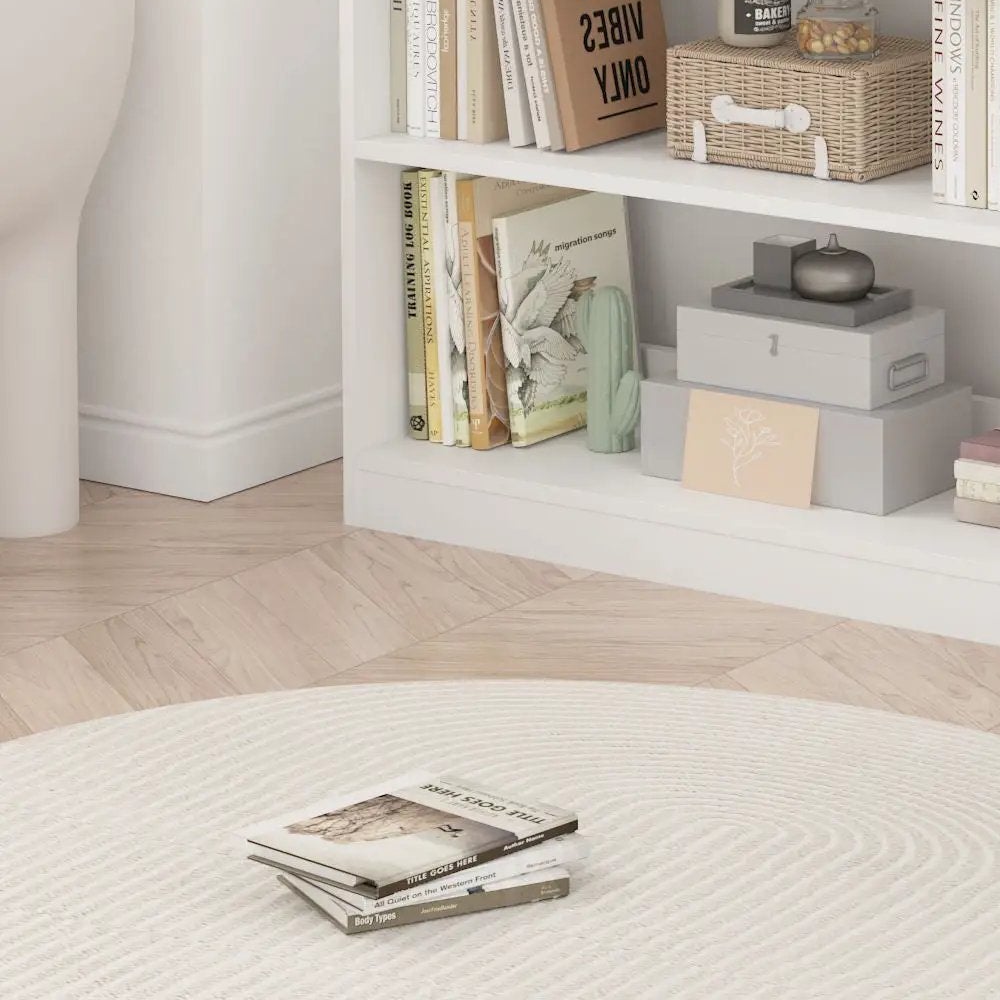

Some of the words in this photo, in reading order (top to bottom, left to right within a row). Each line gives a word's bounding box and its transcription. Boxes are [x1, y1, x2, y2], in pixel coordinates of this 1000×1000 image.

[754, 5, 790, 20] BAKERY
[933, 0, 944, 64] FINE
[425, 0, 438, 123] BRODOVITCH
[933, 77, 944, 171] WINES
[403, 181, 414, 218] BOOK
[420, 177, 430, 252] EXISTENTIAL
[404, 222, 414, 248] LOG
[554, 234, 593, 252] migration
[593, 227, 617, 241] songs
[405, 251, 417, 320] TRAINING
[424, 261, 434, 345] ASPIRATIONS
[419, 783, 462, 799] HERE
[461, 796, 507, 813] GOES
[506, 808, 546, 824] TITLE
[406, 872, 428, 885] TITLE
[430, 863, 455, 877] GOES
[456, 855, 478, 868] HERE
[374, 897, 386, 908] All
[386, 892, 410, 907] Quiet
[412, 891, 423, 900] on
[424, 887, 438, 897] the
[440, 879, 473, 892] Western
[475, 871, 497, 883] Front
[354, 914, 374, 927] Body
[375, 911, 397, 925] Types
